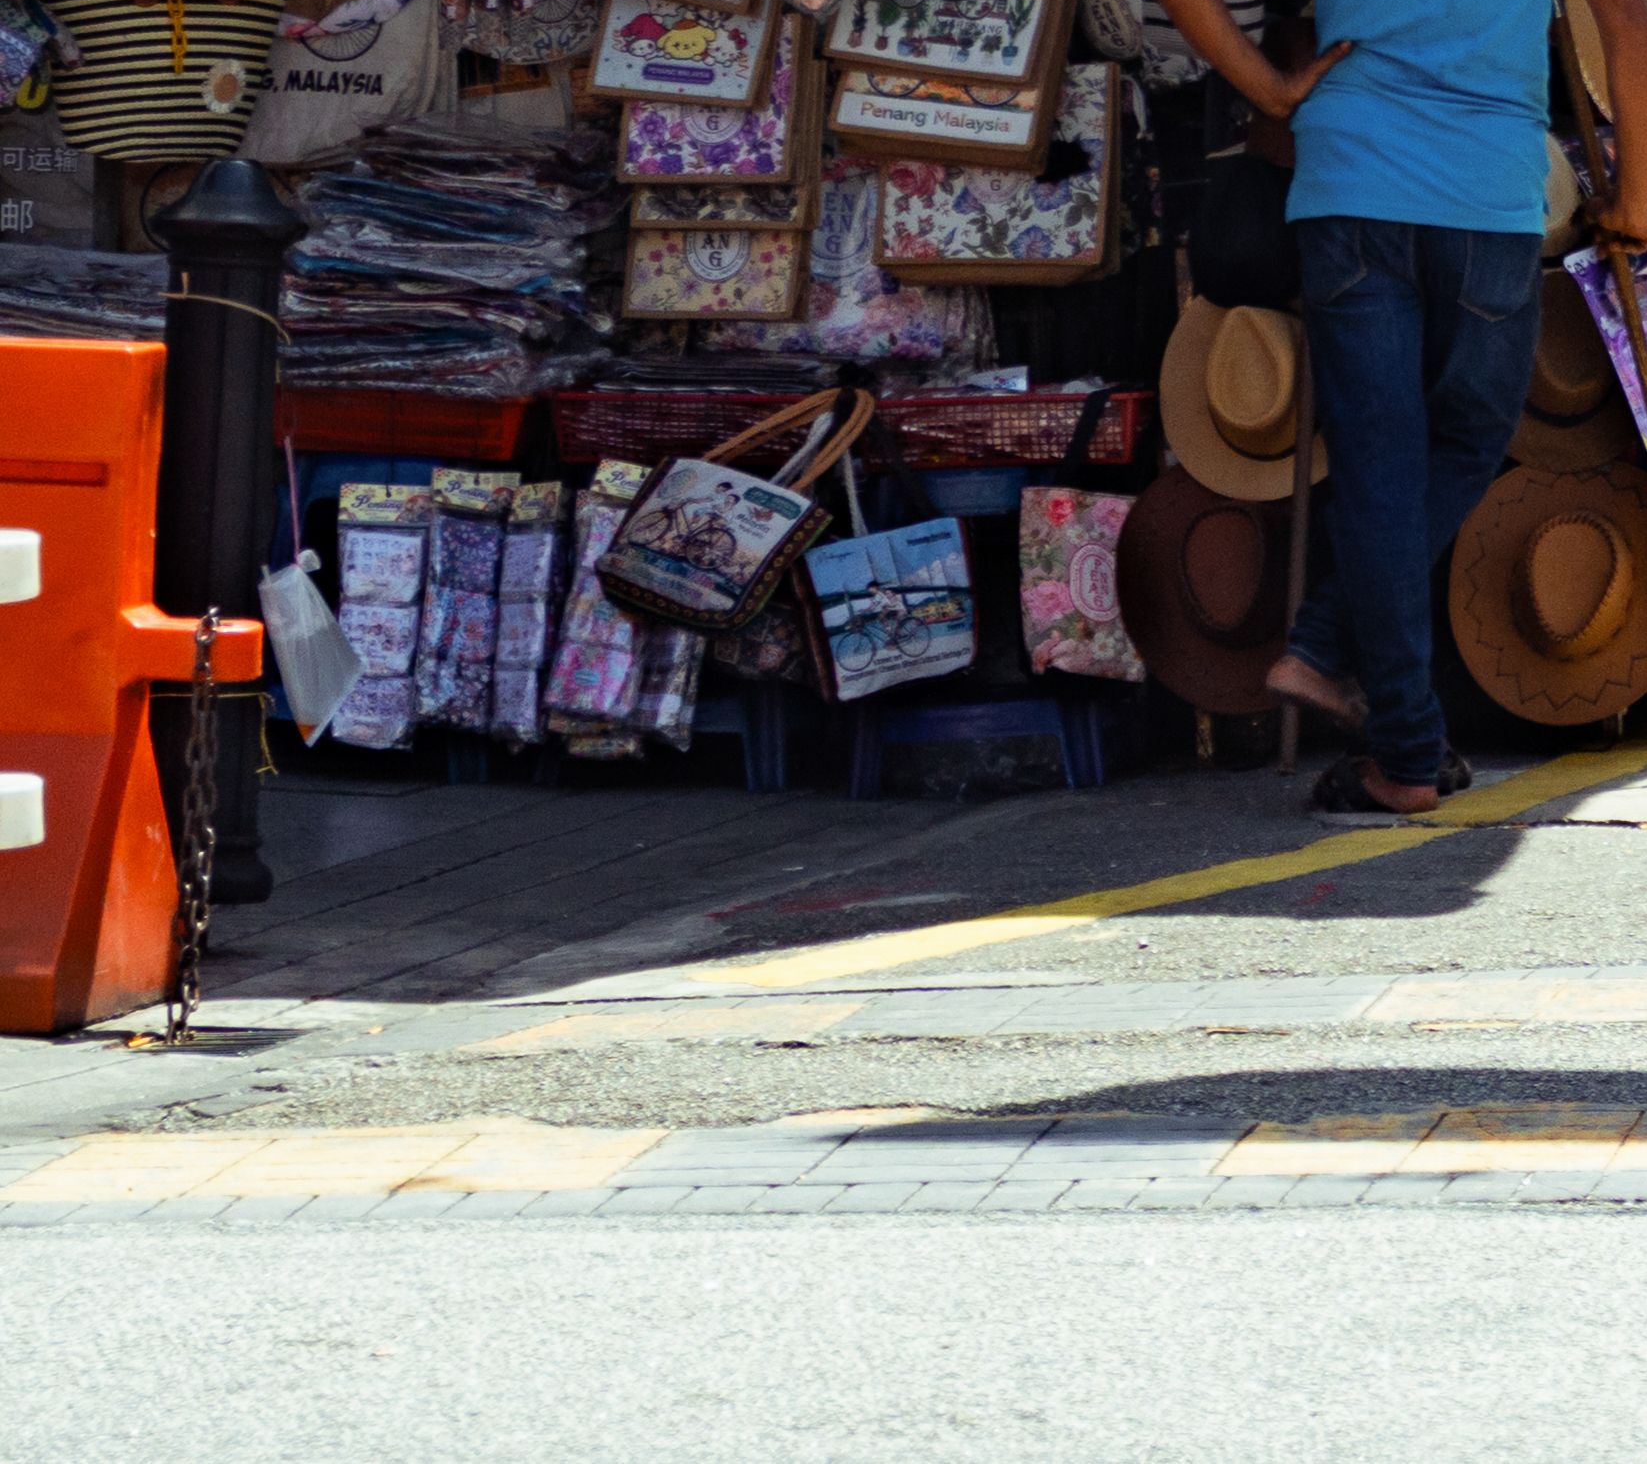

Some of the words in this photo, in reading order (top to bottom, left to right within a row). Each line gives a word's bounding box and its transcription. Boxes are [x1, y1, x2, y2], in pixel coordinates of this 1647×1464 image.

[282, 70, 384, 96] MALAYSIA
[860, 101, 926, 127] Penang
[933, 109, 1010, 133] Malaysia
[2, 147, 79, 173] 可运输
[701, 234, 731, 250] AN
[708, 250, 722, 268] G
